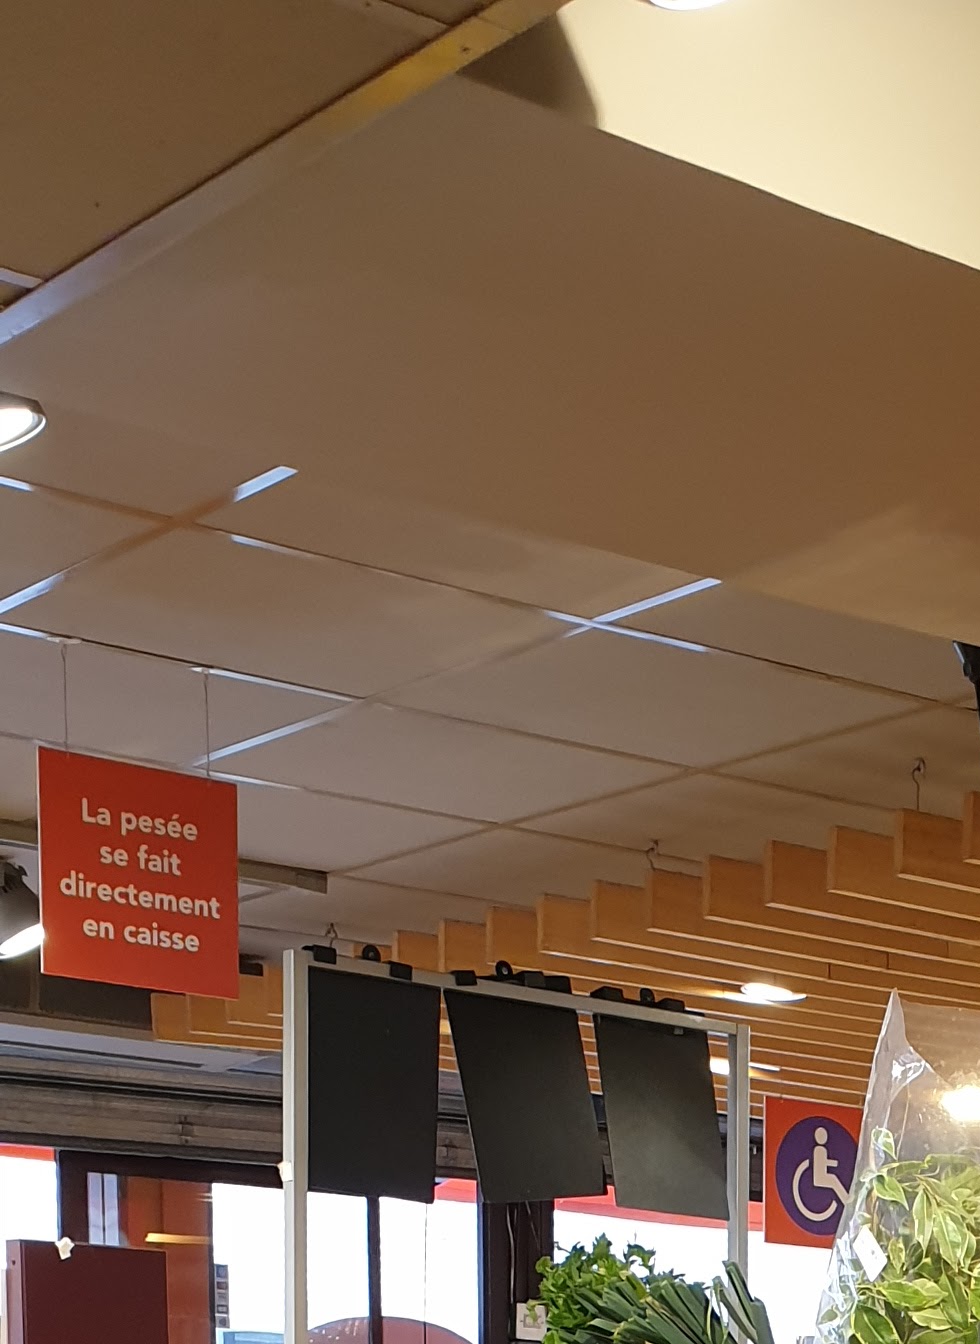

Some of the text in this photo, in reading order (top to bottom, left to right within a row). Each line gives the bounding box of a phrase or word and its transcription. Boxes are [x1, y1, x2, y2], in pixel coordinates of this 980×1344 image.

[81, 797, 198, 841] La pesée
[100, 844, 181, 876] se fait
[60, 870, 221, 919] directement
[83, 918, 200, 952] en caisse
